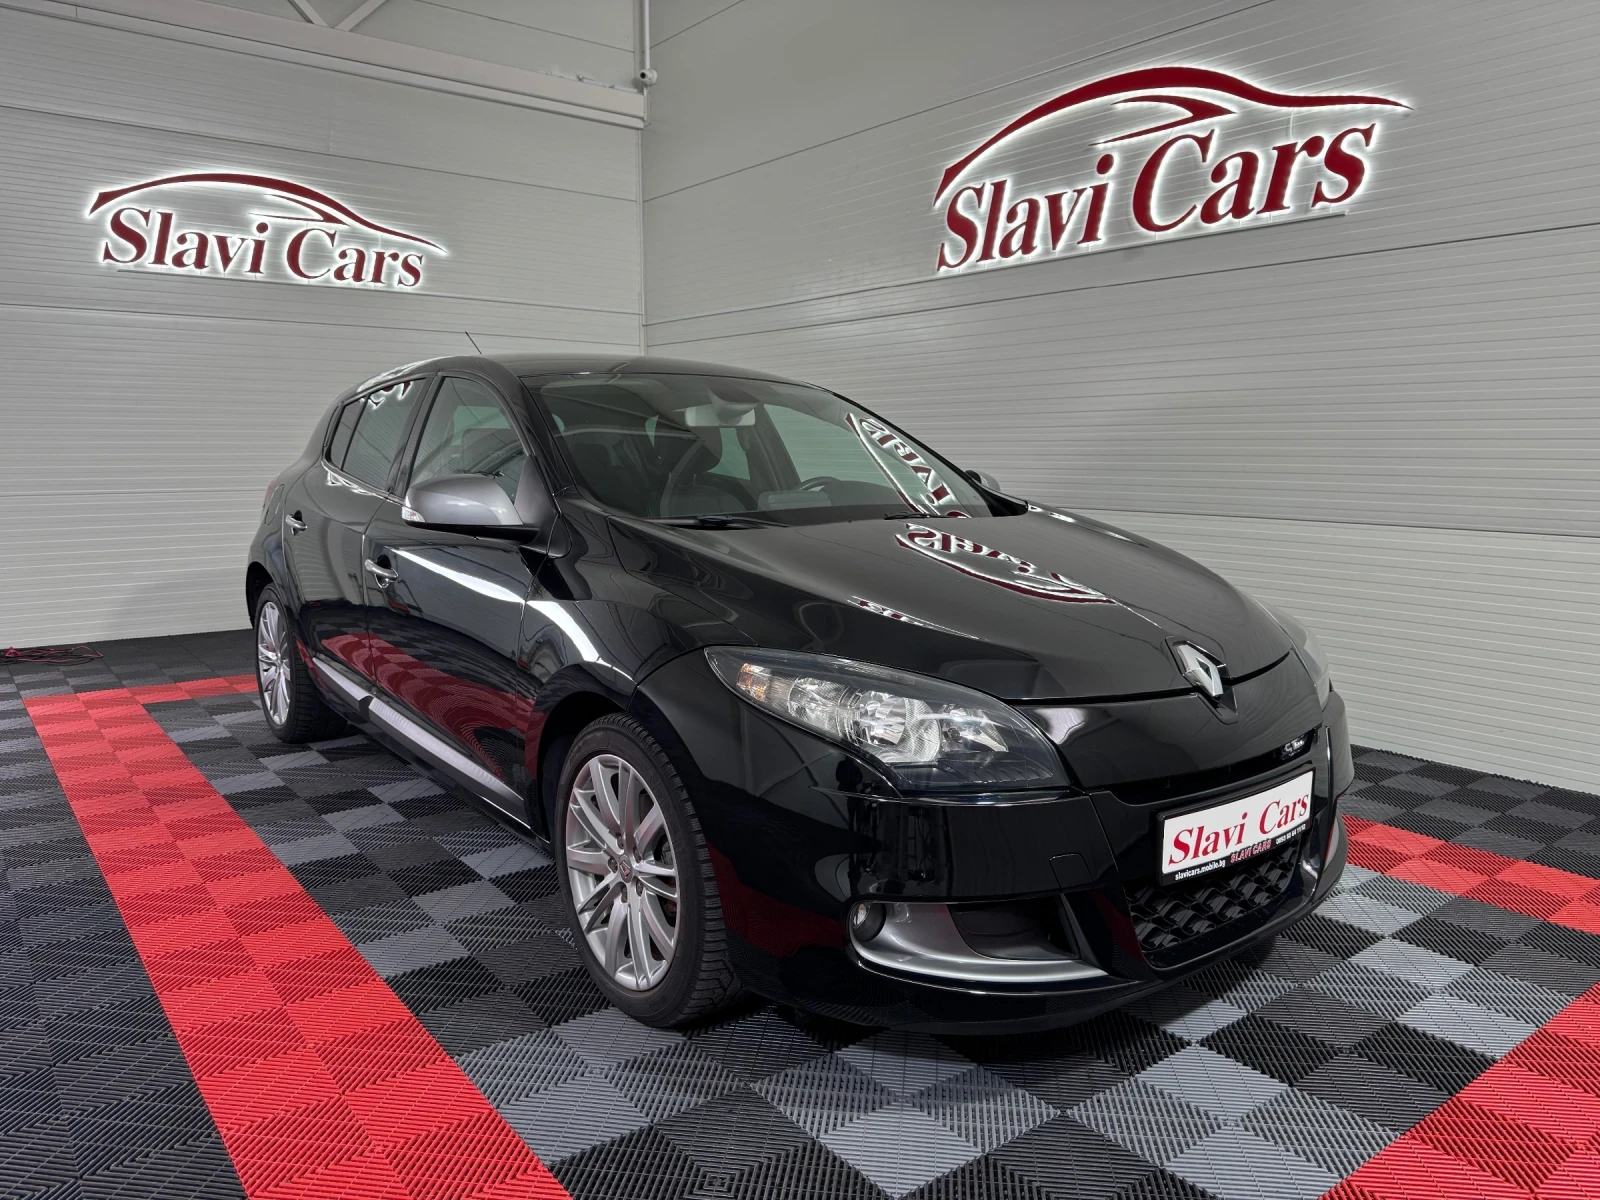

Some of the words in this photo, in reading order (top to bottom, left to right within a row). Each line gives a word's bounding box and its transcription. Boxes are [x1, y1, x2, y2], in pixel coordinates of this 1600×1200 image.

[937, 153, 1115, 272] Slavi
[1132, 123, 1377, 233] Cars
[102, 207, 269, 275] Slavi
[286, 228, 425, 287] Cars
[1168, 812, 1248, 866] Slavi
[1259, 793, 1309, 835] Cars
[1230, 846, 1252, 864] SLAVI
[1252, 839, 1272, 856] CARS
[1174, 859, 1226, 881] slavicars.mobile.bg
